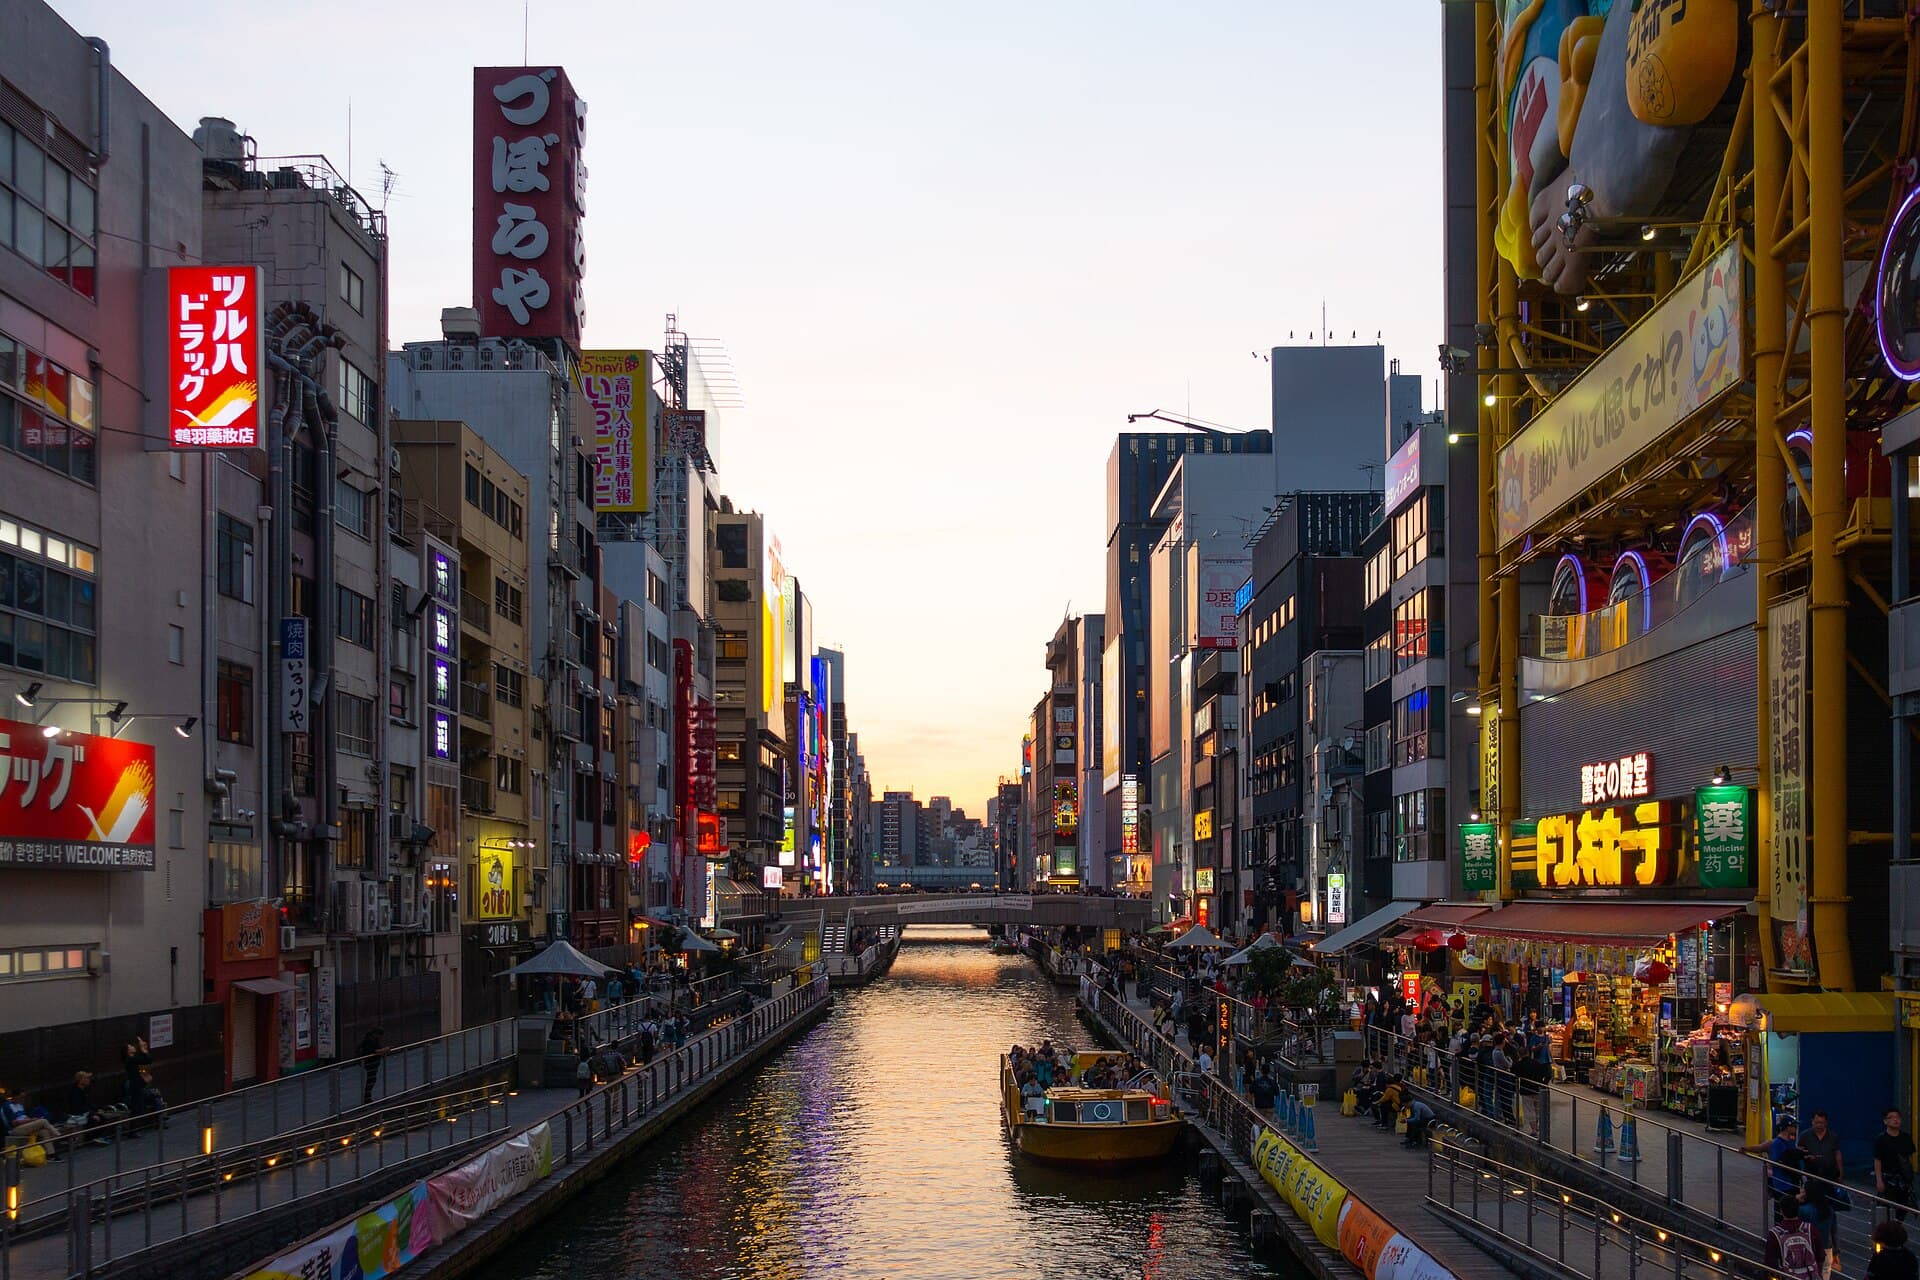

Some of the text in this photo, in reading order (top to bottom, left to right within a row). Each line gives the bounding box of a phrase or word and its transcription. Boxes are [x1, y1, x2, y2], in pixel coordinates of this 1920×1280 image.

[492, 69, 560, 325] づぼらや
[179, 293, 209, 402] ドラッグ
[212, 275, 248, 375] ツルハ
[615, 377, 632, 505] 高収入お仕事情報
[287, 660, 304, 729] いろりや
[1581, 753, 1649, 805] 驚安の殿堂
[1465, 834, 1492, 860] 薬
[1702, 801, 1744, 842] 薬
[1703, 845, 1745, 853] Medicine
[66, 845, 121, 866] WELCOME
